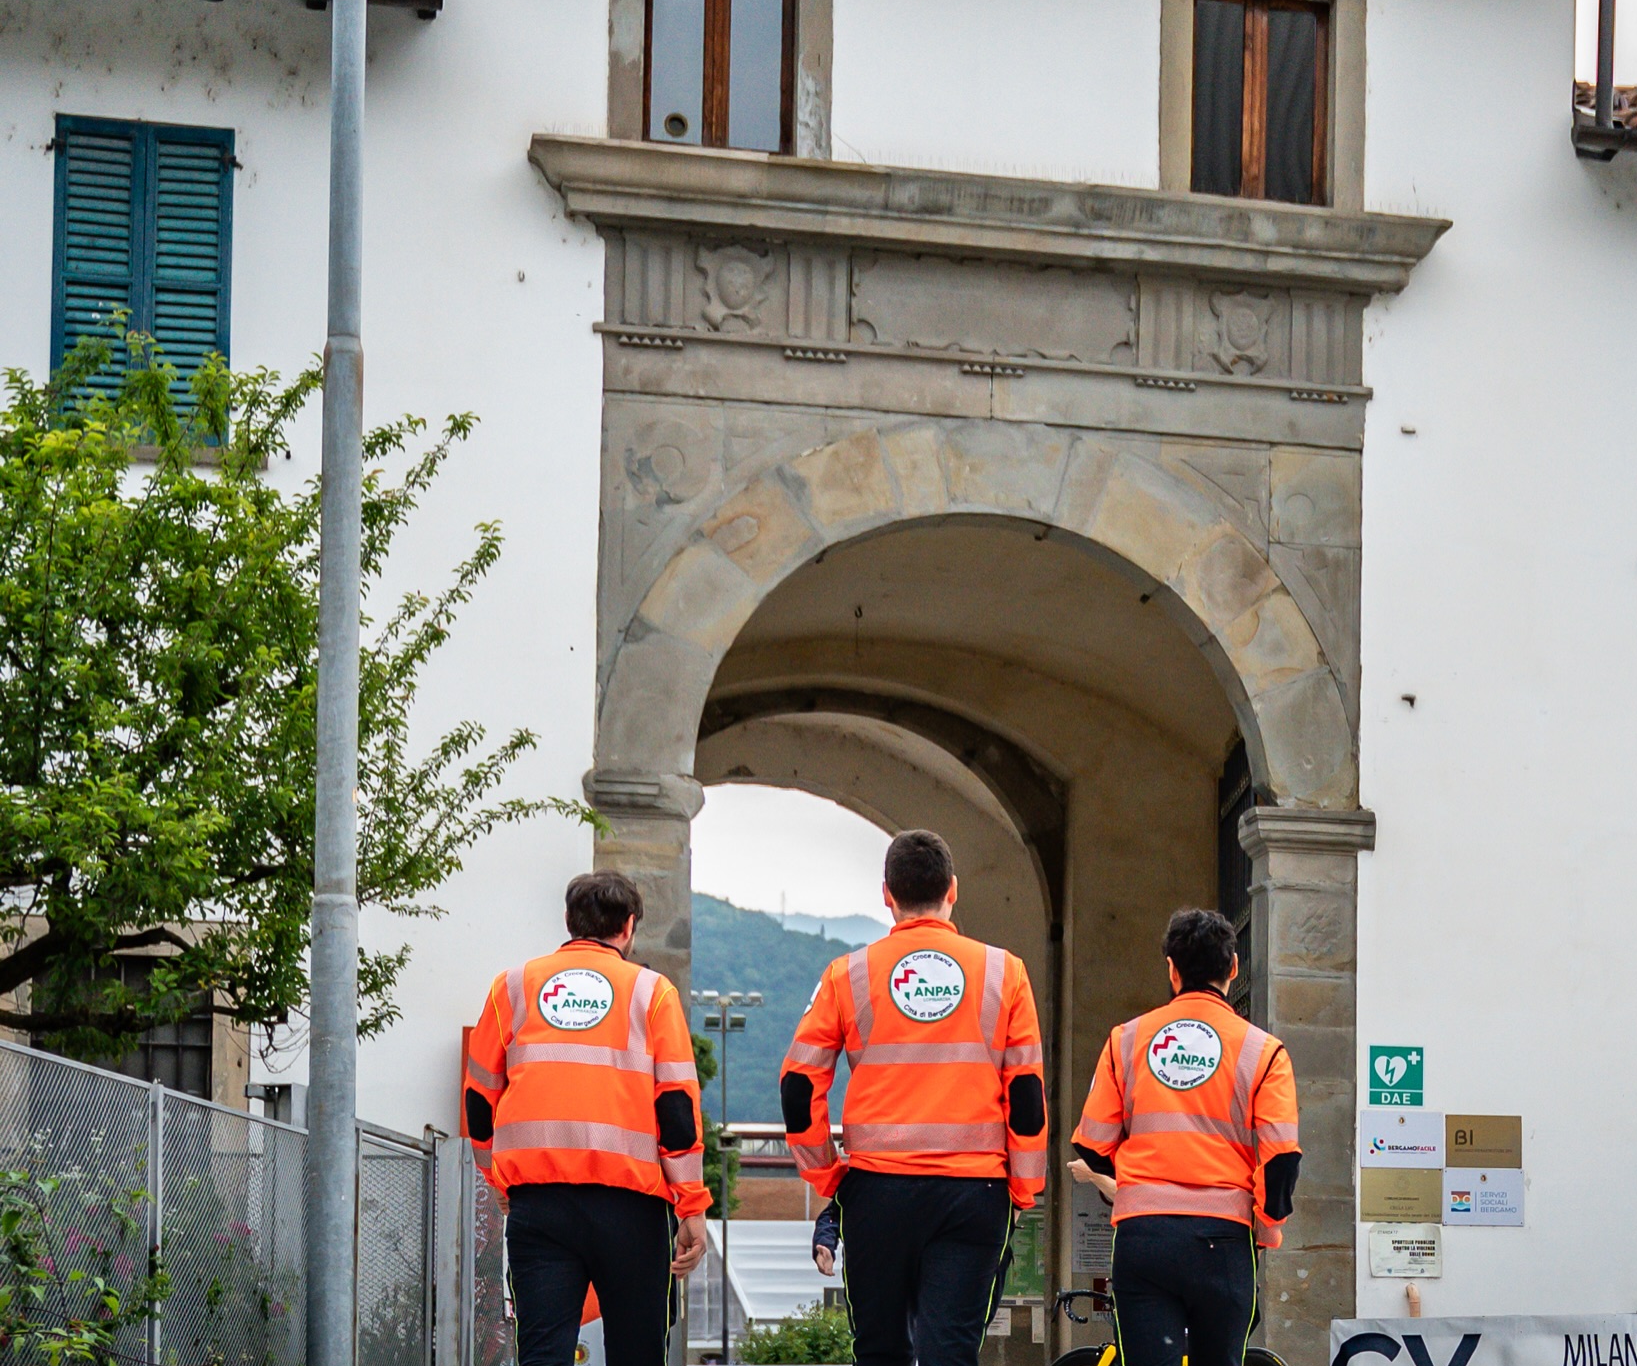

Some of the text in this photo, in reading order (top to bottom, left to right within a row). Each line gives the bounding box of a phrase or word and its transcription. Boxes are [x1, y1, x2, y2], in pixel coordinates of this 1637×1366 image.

[933, 953, 953, 968] Bianca
[914, 985, 960, 997] ANPAS
[561, 999, 608, 1010] ANPAS
[928, 1003, 954, 1018] Bergamo
[1196, 1023, 1213, 1039] Bianca
[1170, 1053, 1215, 1068] ANPAS
[1180, 1073, 1205, 1087] Bergamo
[1381, 1092, 1411, 1104] DAE
[1455, 1129, 1473, 1145] BI
